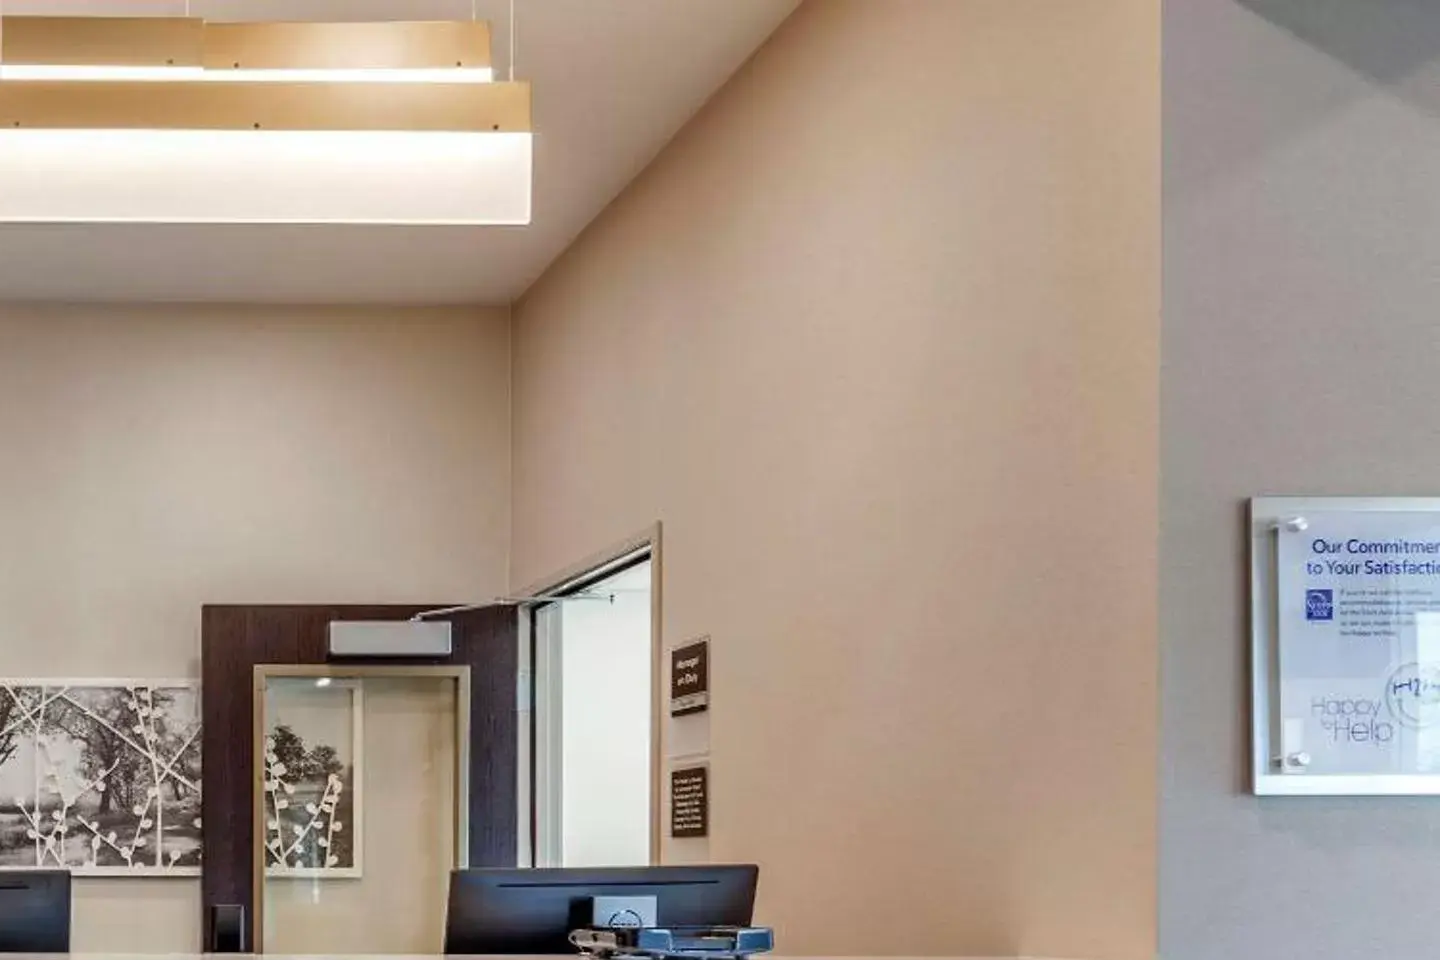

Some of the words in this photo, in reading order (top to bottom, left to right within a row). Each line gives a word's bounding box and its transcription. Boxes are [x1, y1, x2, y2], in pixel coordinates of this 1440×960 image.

[1312, 538, 1342, 554] Our
[1306, 562, 1324, 575] to
[1326, 560, 1360, 575] Your
[1310, 695, 1382, 718] Happy
[1333, 717, 1394, 747] Help
